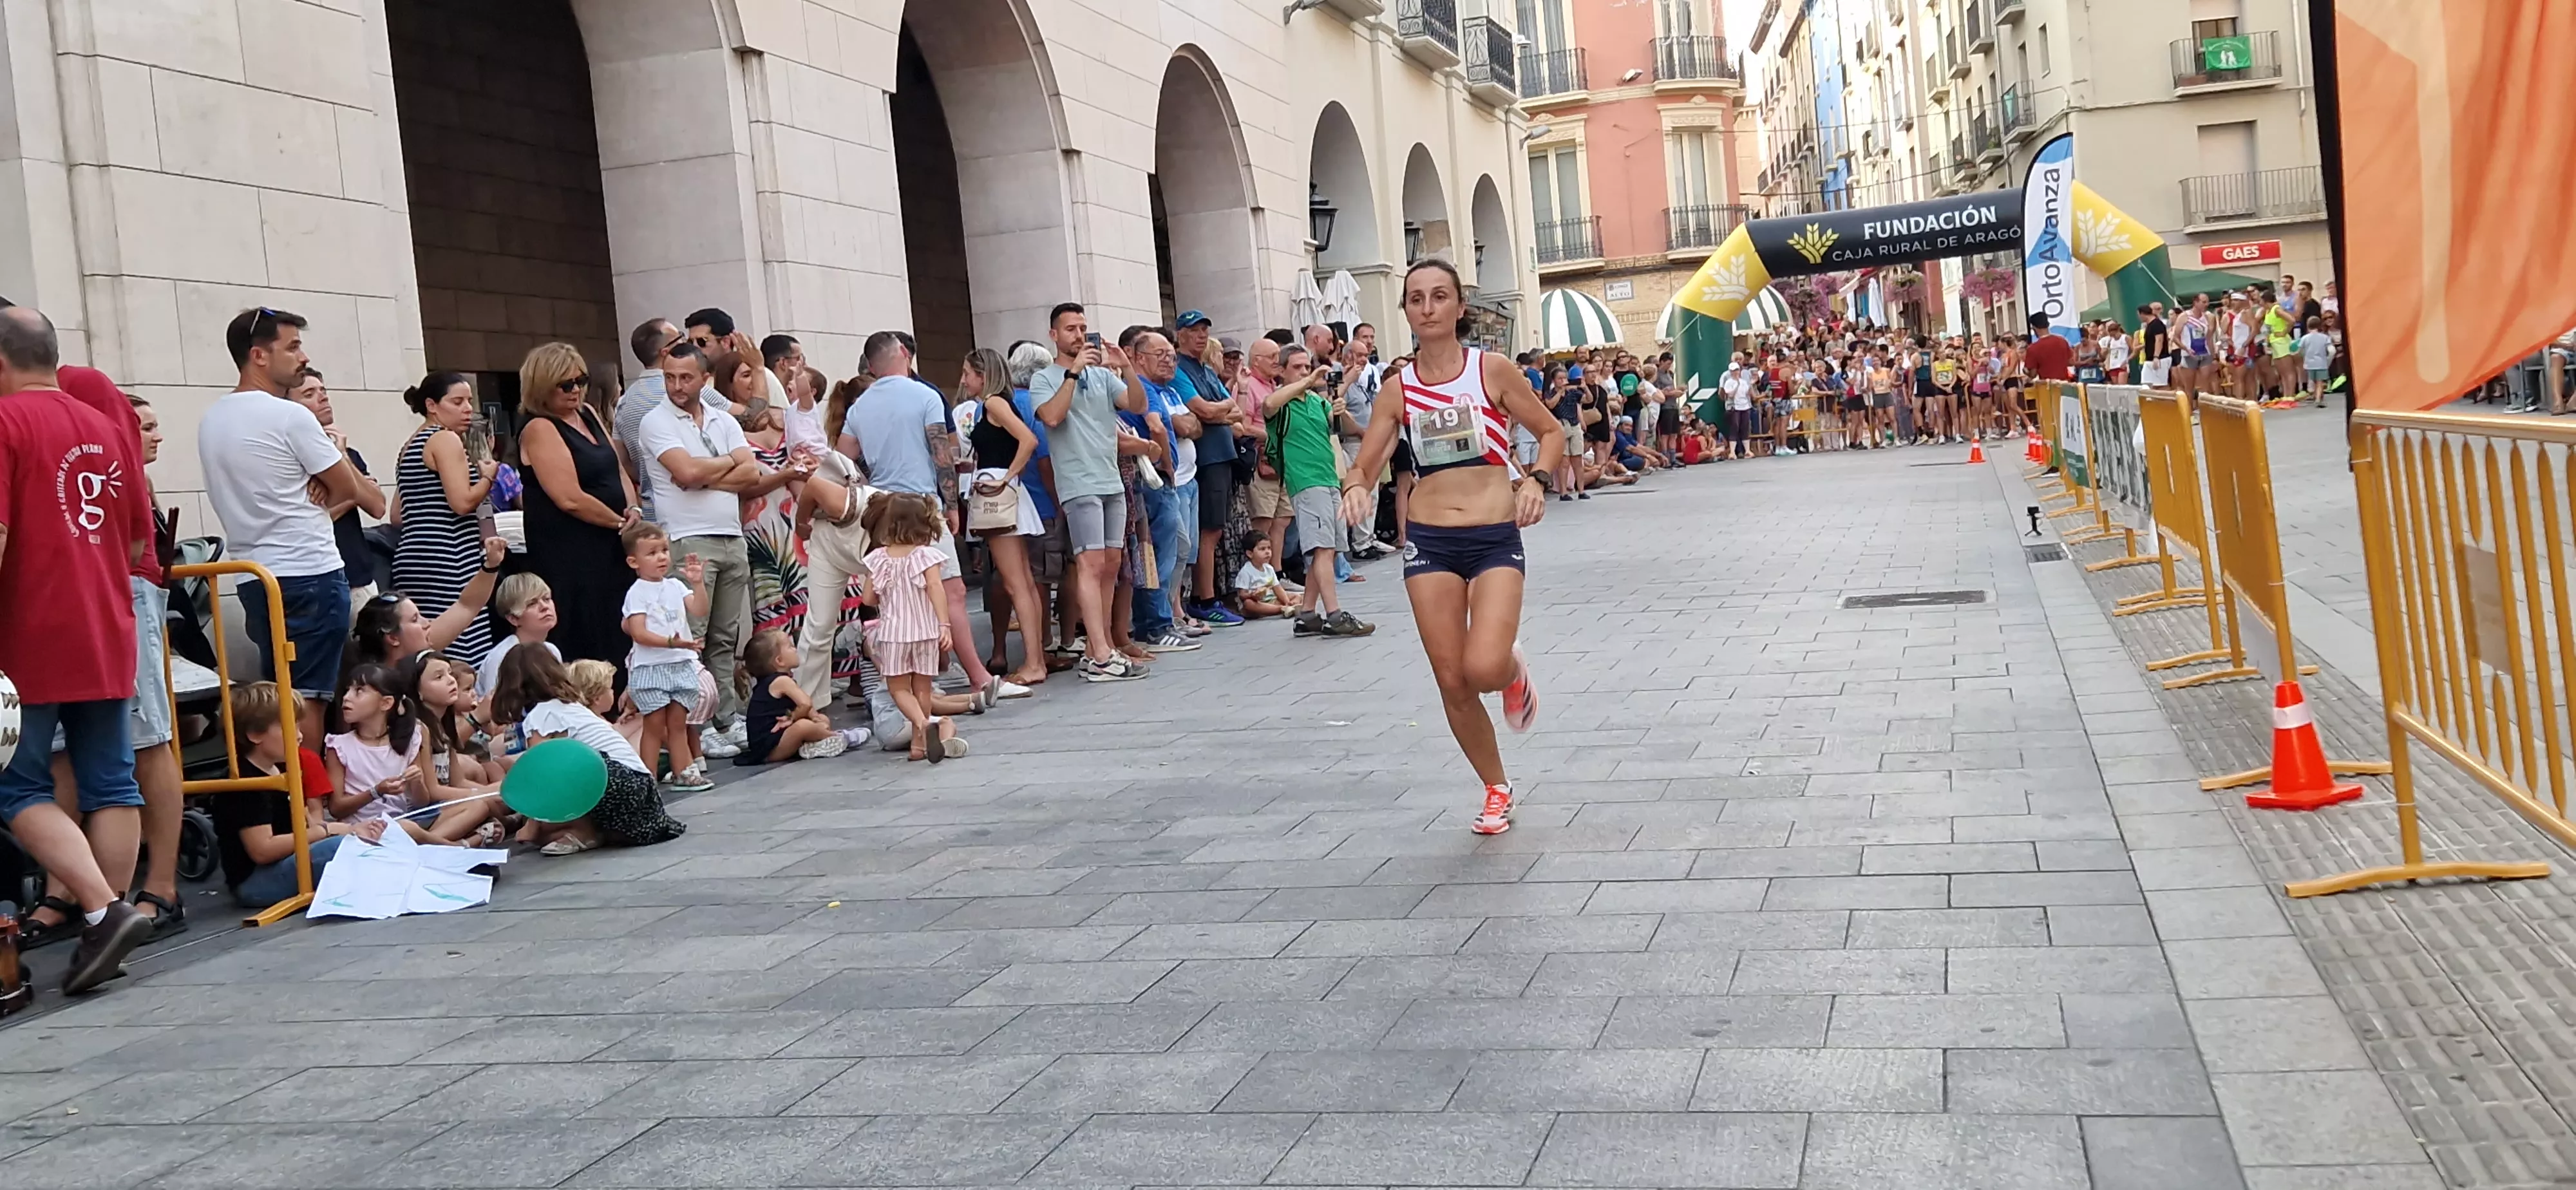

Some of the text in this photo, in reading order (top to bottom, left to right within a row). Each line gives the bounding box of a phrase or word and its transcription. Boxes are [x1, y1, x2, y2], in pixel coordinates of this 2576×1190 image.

[1863, 204, 1997, 240] FUNDACIÓN
[1832, 247, 1873, 261] CAJA
[1879, 240, 1932, 256] RURAL
[1937, 235, 1958, 249] DE
[2038, 167, 2064, 319] OrtoAvanza
[2222, 245, 2260, 260] GAES
[1430, 408, 1459, 429] 19
